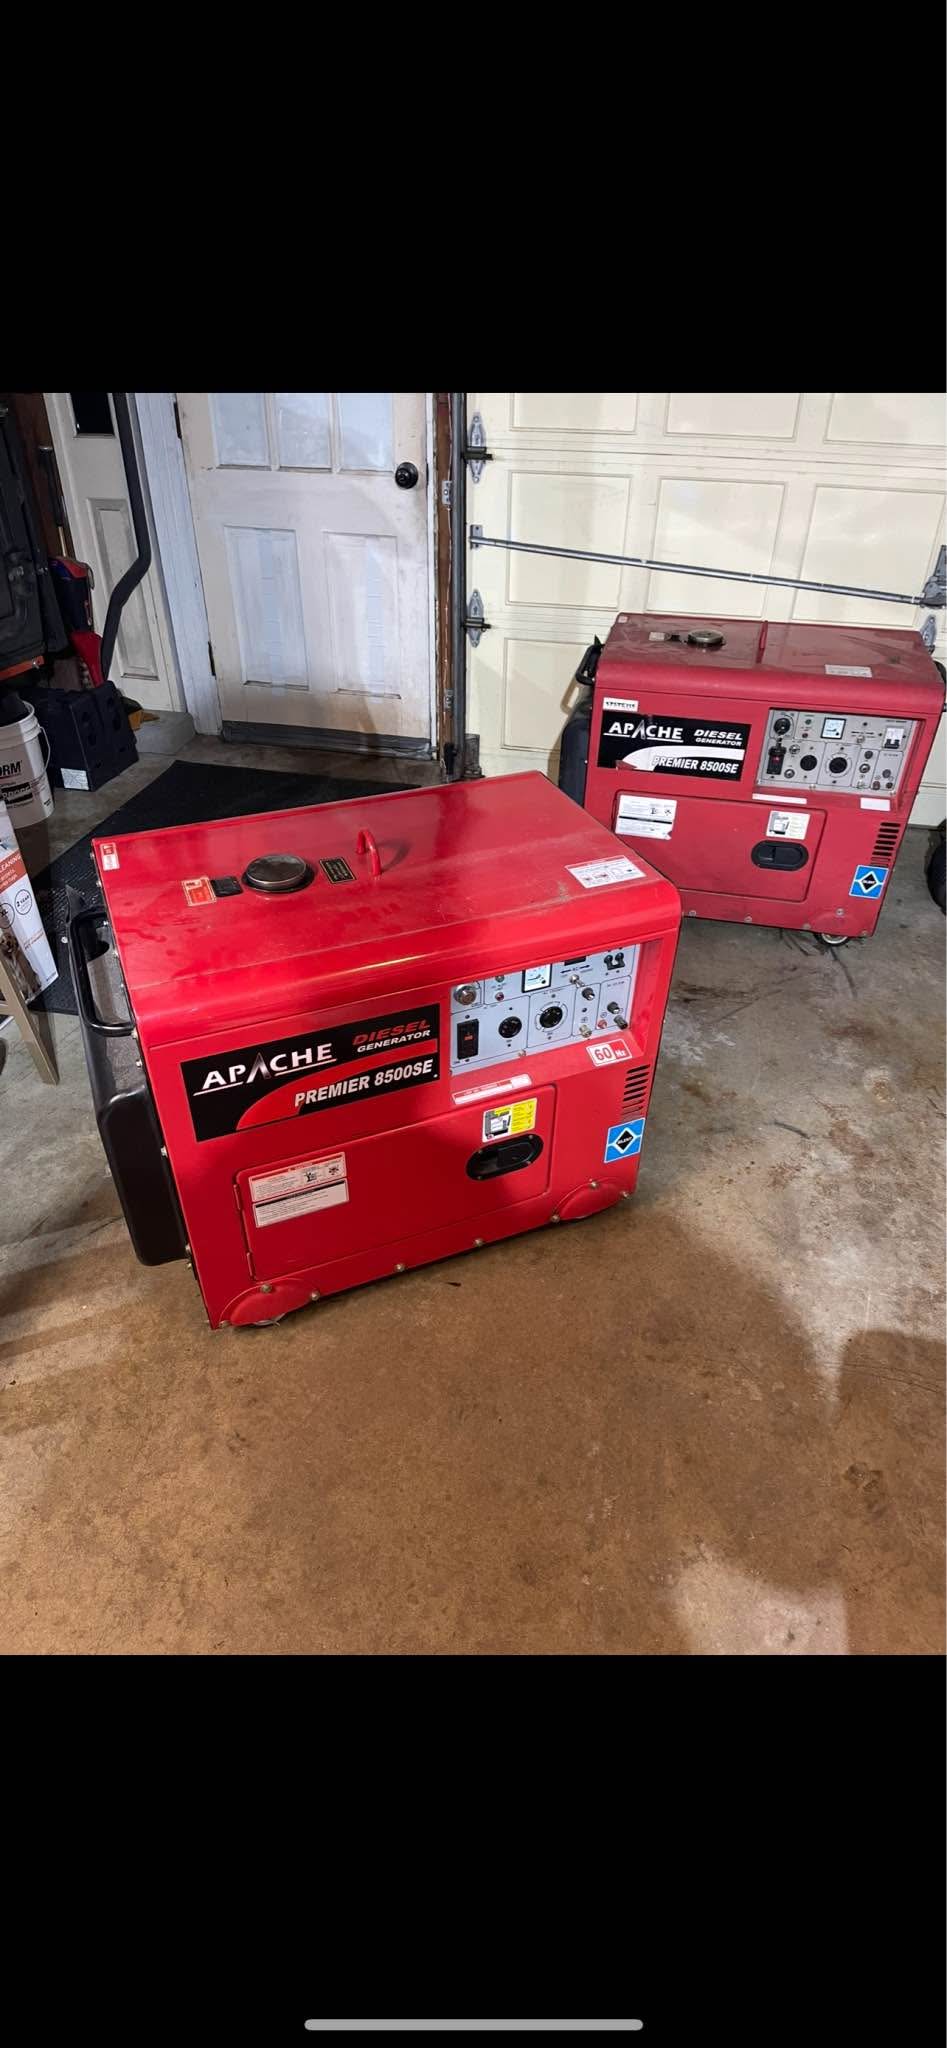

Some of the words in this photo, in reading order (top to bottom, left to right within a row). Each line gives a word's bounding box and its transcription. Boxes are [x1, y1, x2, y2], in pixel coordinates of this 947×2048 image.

[608, 719, 683, 740] APACHE
[693, 728, 744, 741] DIESEL
[695, 738, 742, 747] GENERATOR
[651, 755, 698, 770] PREMIER
[700, 761, 739, 774] 8500SE
[352, 1019, 431, 1045] DIESEL
[357, 1030, 431, 1053] GENERATOR
[594, 1047, 612, 1061] 60
[614, 1049, 626, 1059] Hz
[202, 1043, 332, 1090] APACHE
[374, 1059, 434, 1086] 8500SE
[294, 1076, 370, 1107] PREMIER
